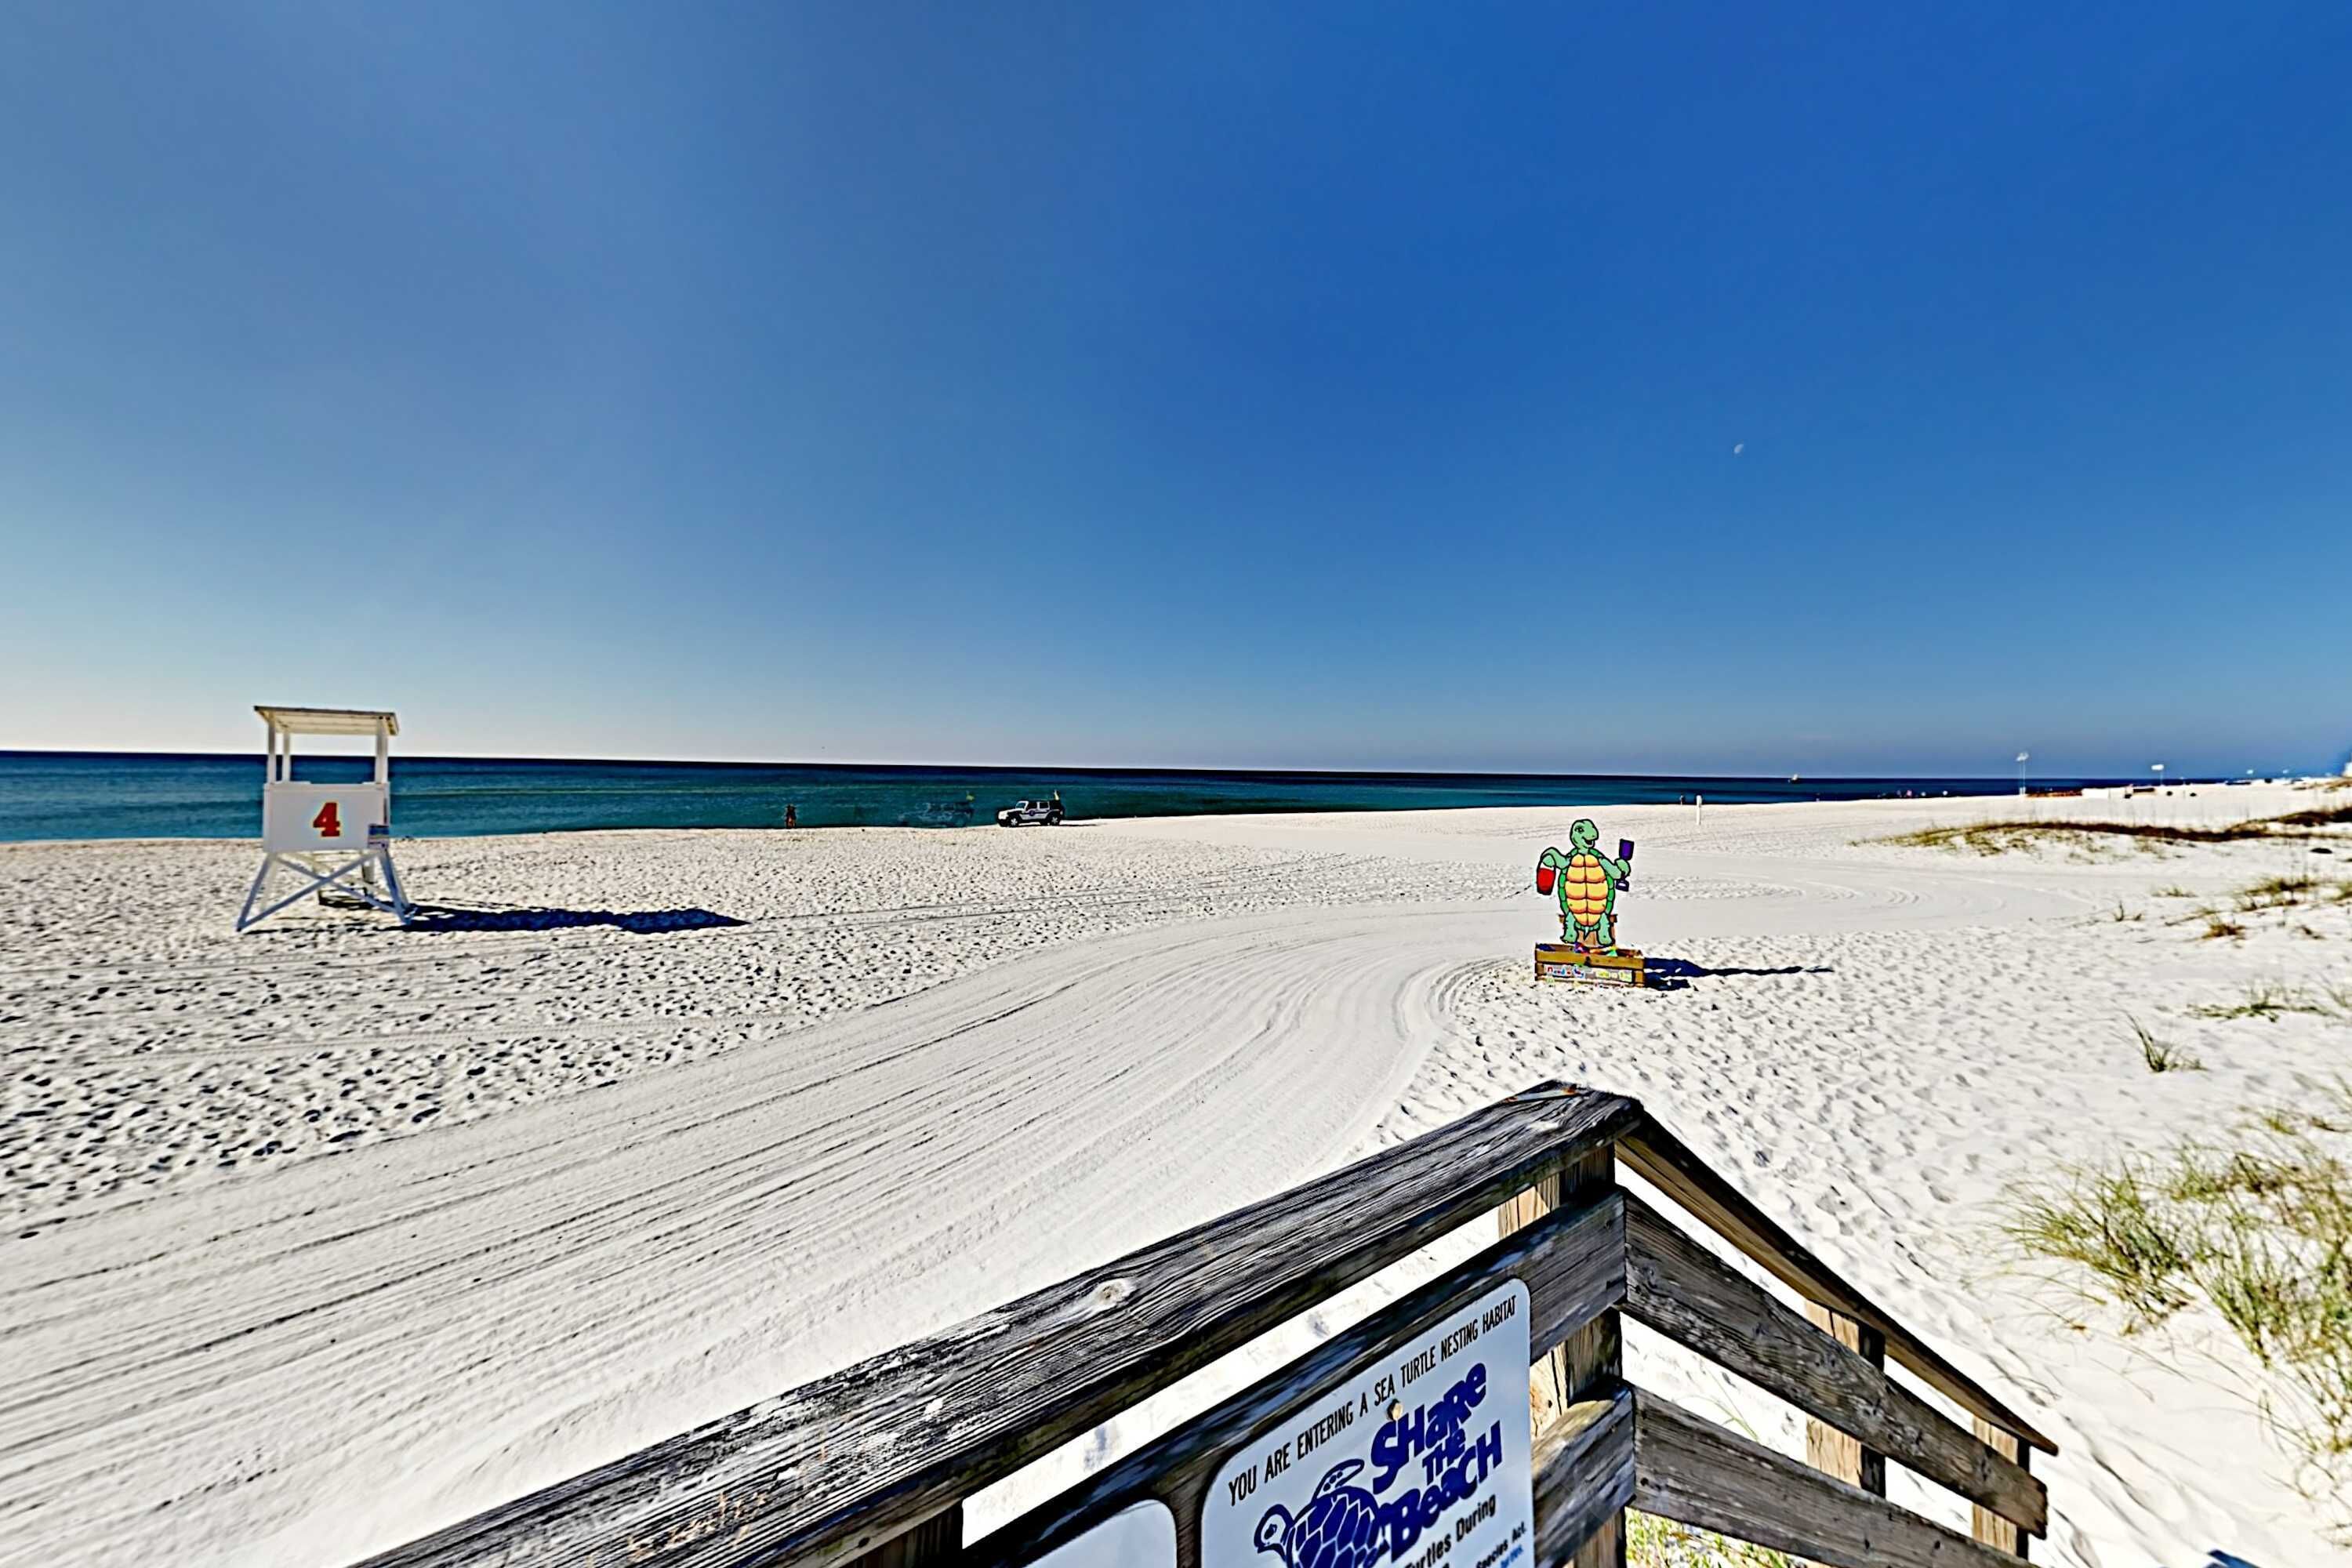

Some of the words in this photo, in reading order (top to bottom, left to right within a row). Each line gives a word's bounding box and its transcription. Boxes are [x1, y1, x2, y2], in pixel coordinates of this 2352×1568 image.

[313, 801, 340, 837] 4
[1229, 1465, 1257, 1506] YOU
[1264, 1442, 1291, 1483] ARE
[1297, 1401, 1354, 1461] ENTERING
[1359, 1392, 1369, 1417] A
[1374, 1374, 1396, 1406] SEA
[1400, 1345, 1436, 1388] TURTLE
[1440, 1319, 1479, 1362] NESTING
[1482, 1295, 1516, 1334] HABITAT
[1404, 1534, 1452, 1568] rtles
[1456, 1494, 1497, 1542] During
